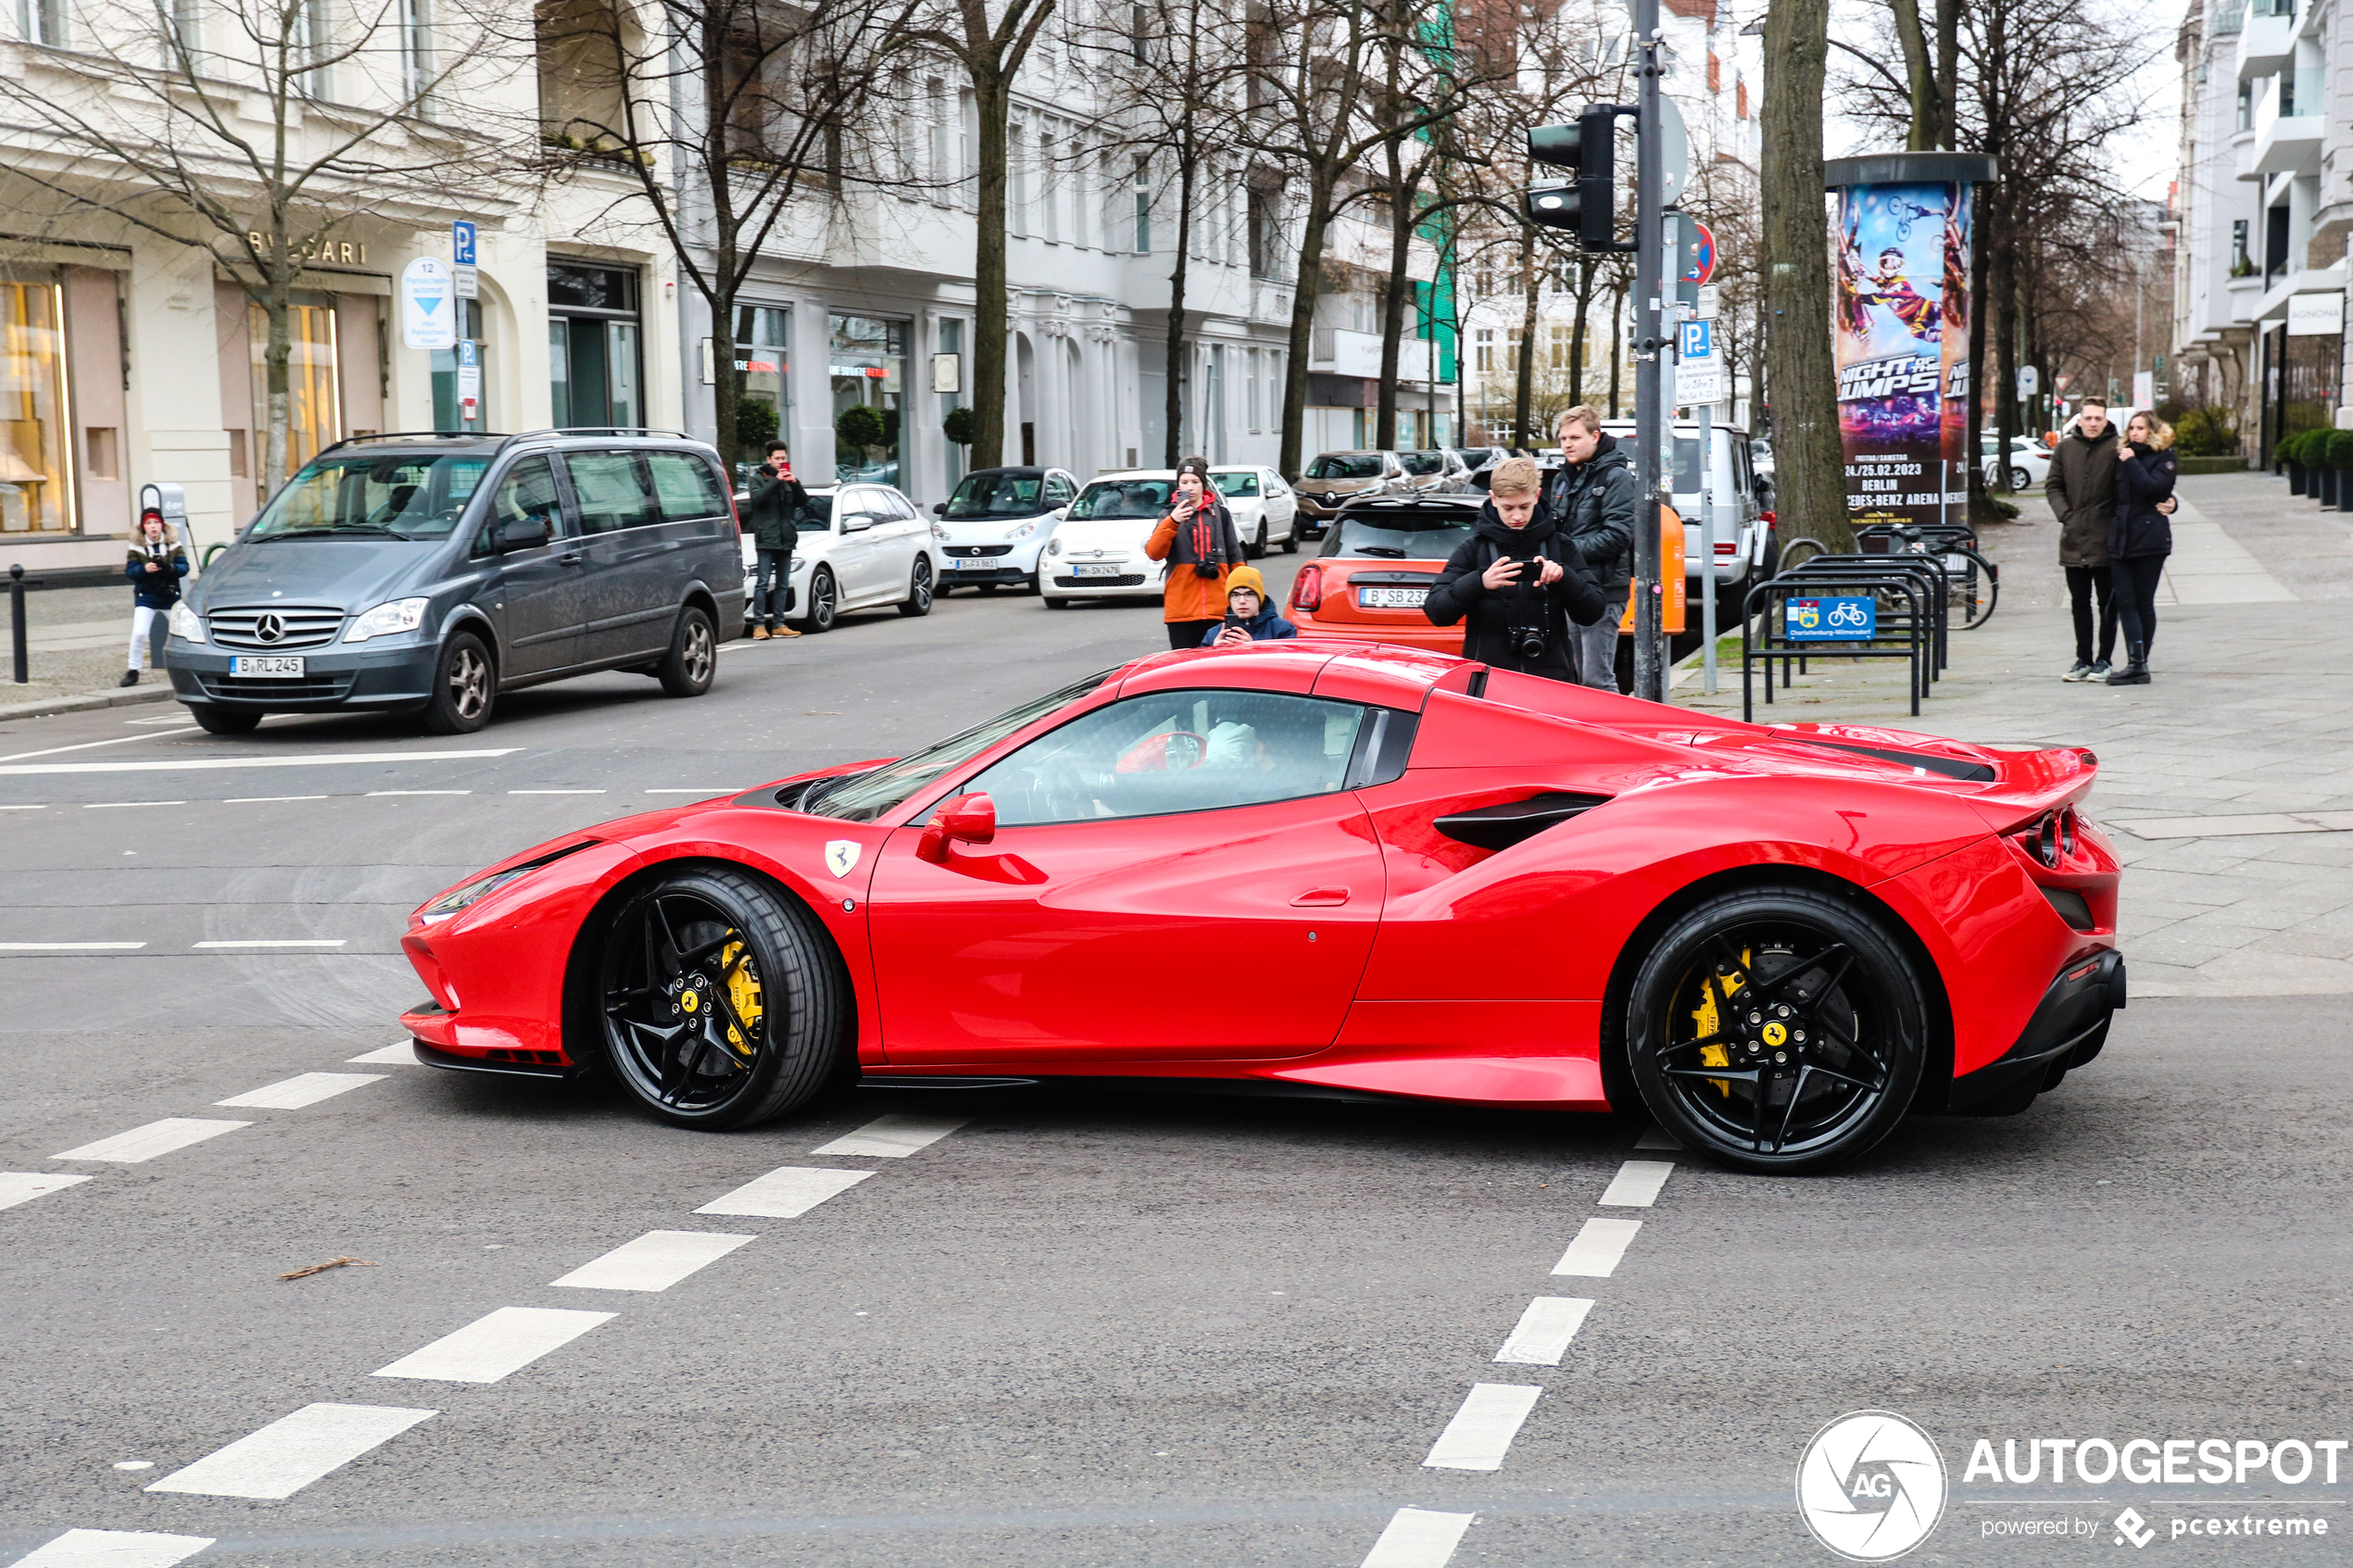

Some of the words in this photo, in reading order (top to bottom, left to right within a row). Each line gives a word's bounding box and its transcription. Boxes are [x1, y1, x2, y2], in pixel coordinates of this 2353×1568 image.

[422, 263, 434, 273] 12
[2292, 309, 2340, 319] AGNONA
[1839, 356, 1917, 384] NIGHT
[1915, 356, 1936, 365] OF
[1910, 361, 1941, 373] THE
[1837, 370, 1941, 401] JUMPS
[1844, 463, 1922, 477] 24./25.02.2023
[1861, 479, 1898, 492] BERLIN
[1846, 494, 1904, 507] CEDES-BENZ
[1906, 493, 1940, 506] ARENA
[1371, 590, 1378, 602] B
[1388, 590, 1403, 602] SB
[242, 659, 248, 671] B
[257, 659, 272, 671] RL
[275, 659, 298, 671] 245
